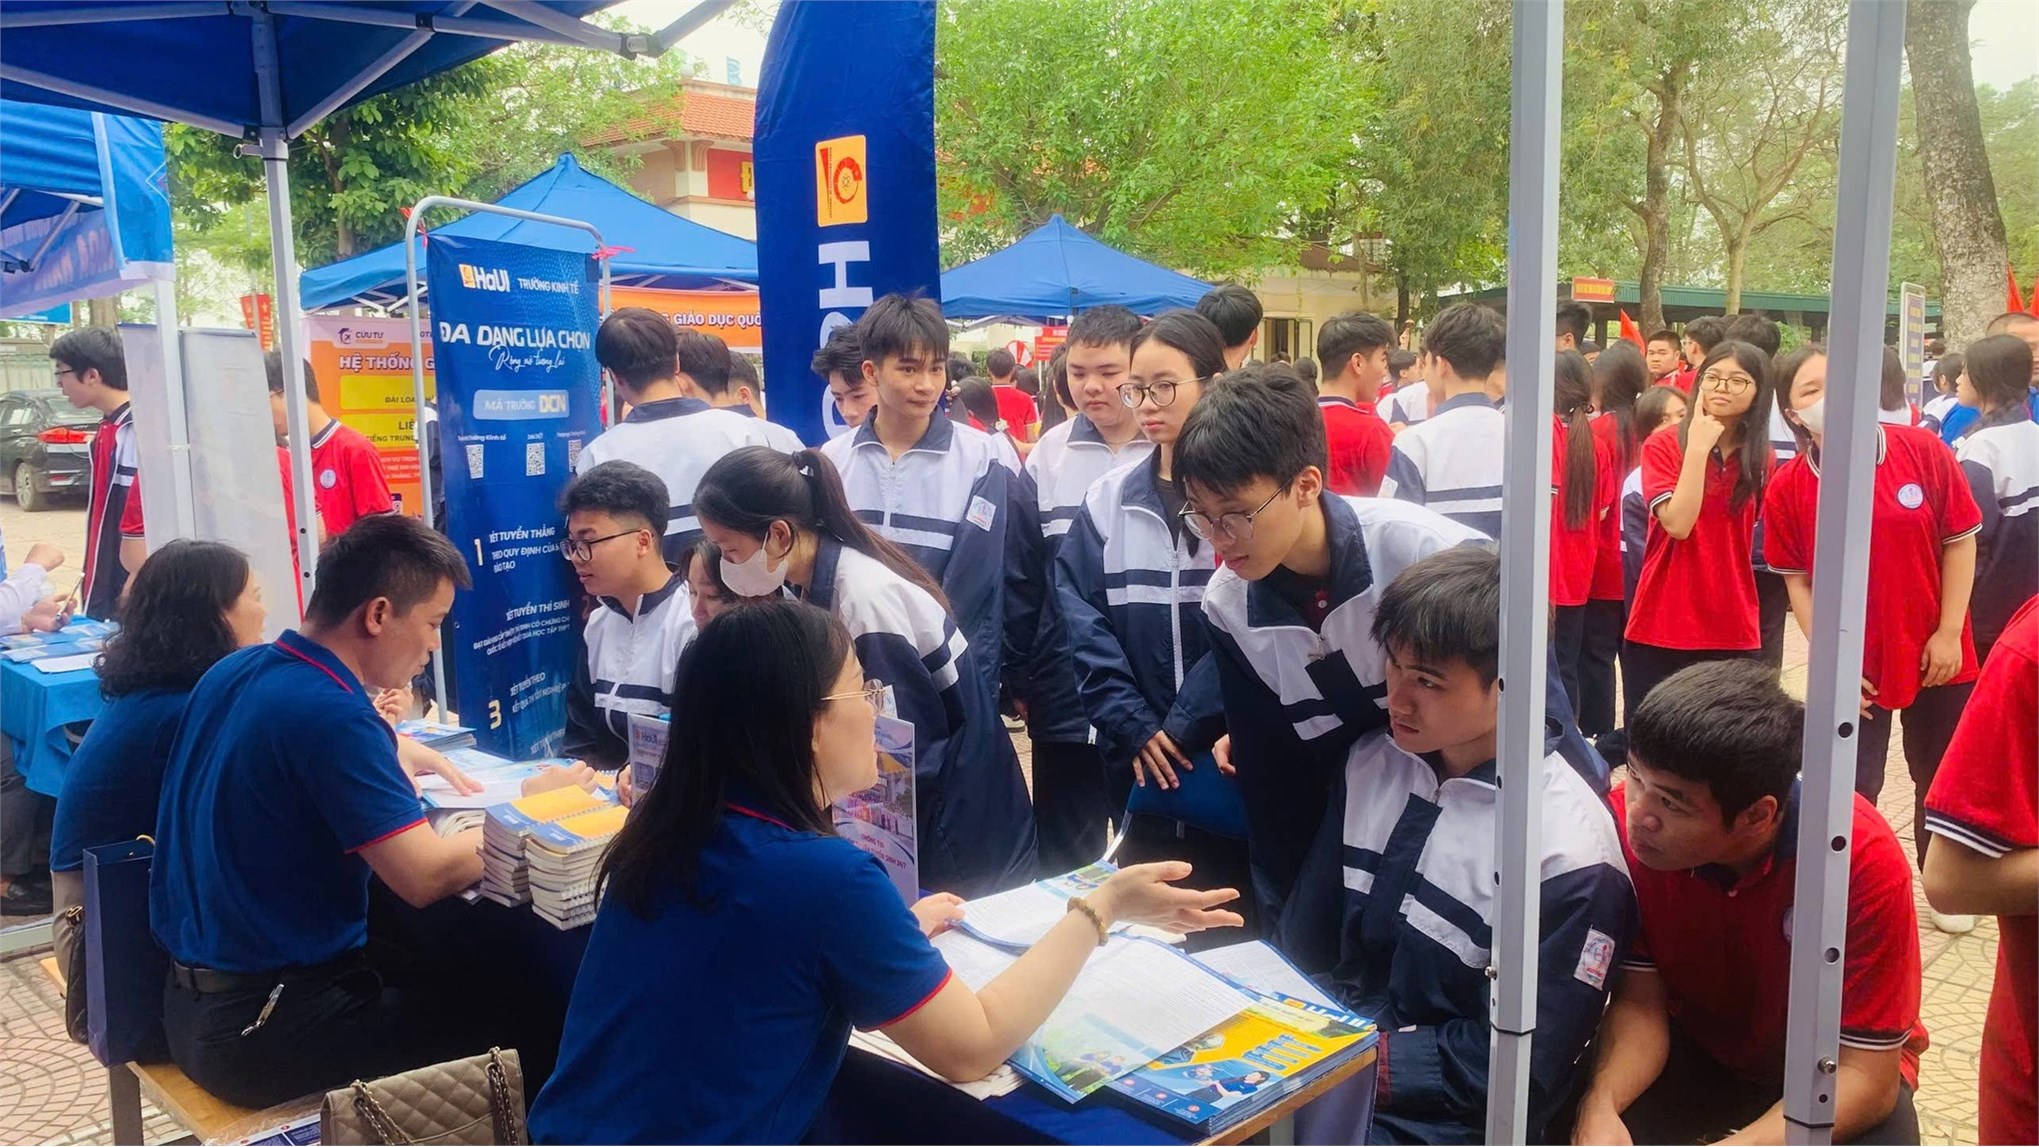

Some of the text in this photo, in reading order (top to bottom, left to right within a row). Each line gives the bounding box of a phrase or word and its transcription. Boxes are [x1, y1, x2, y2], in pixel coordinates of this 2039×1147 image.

[517, 277, 551, 292] TRƯỜNG
[551, 280, 569, 294] KINH
[568, 279, 580, 295] TẾ
[673, 310, 704, 325] GIÁO
[708, 313, 735, 329] DỤC
[476, 325, 525, 350] DẠNG
[526, 327, 557, 351] LỰA
[557, 329, 591, 353] CHỌN
[339, 352, 362, 373] HỆ
[538, 394, 566, 413] DCN
[398, 418, 415, 430] LIÊ
[500, 526, 529, 541] TUYỂN
[473, 537, 484, 567] 1
[503, 547, 520, 559] QUY
[521, 545, 542, 558] ĐỊNH
[502, 560, 517, 572] TẠO
[513, 601, 537, 618] TUYỂN
[553, 600, 570, 612] SINH
[488, 699, 502, 730] 3
